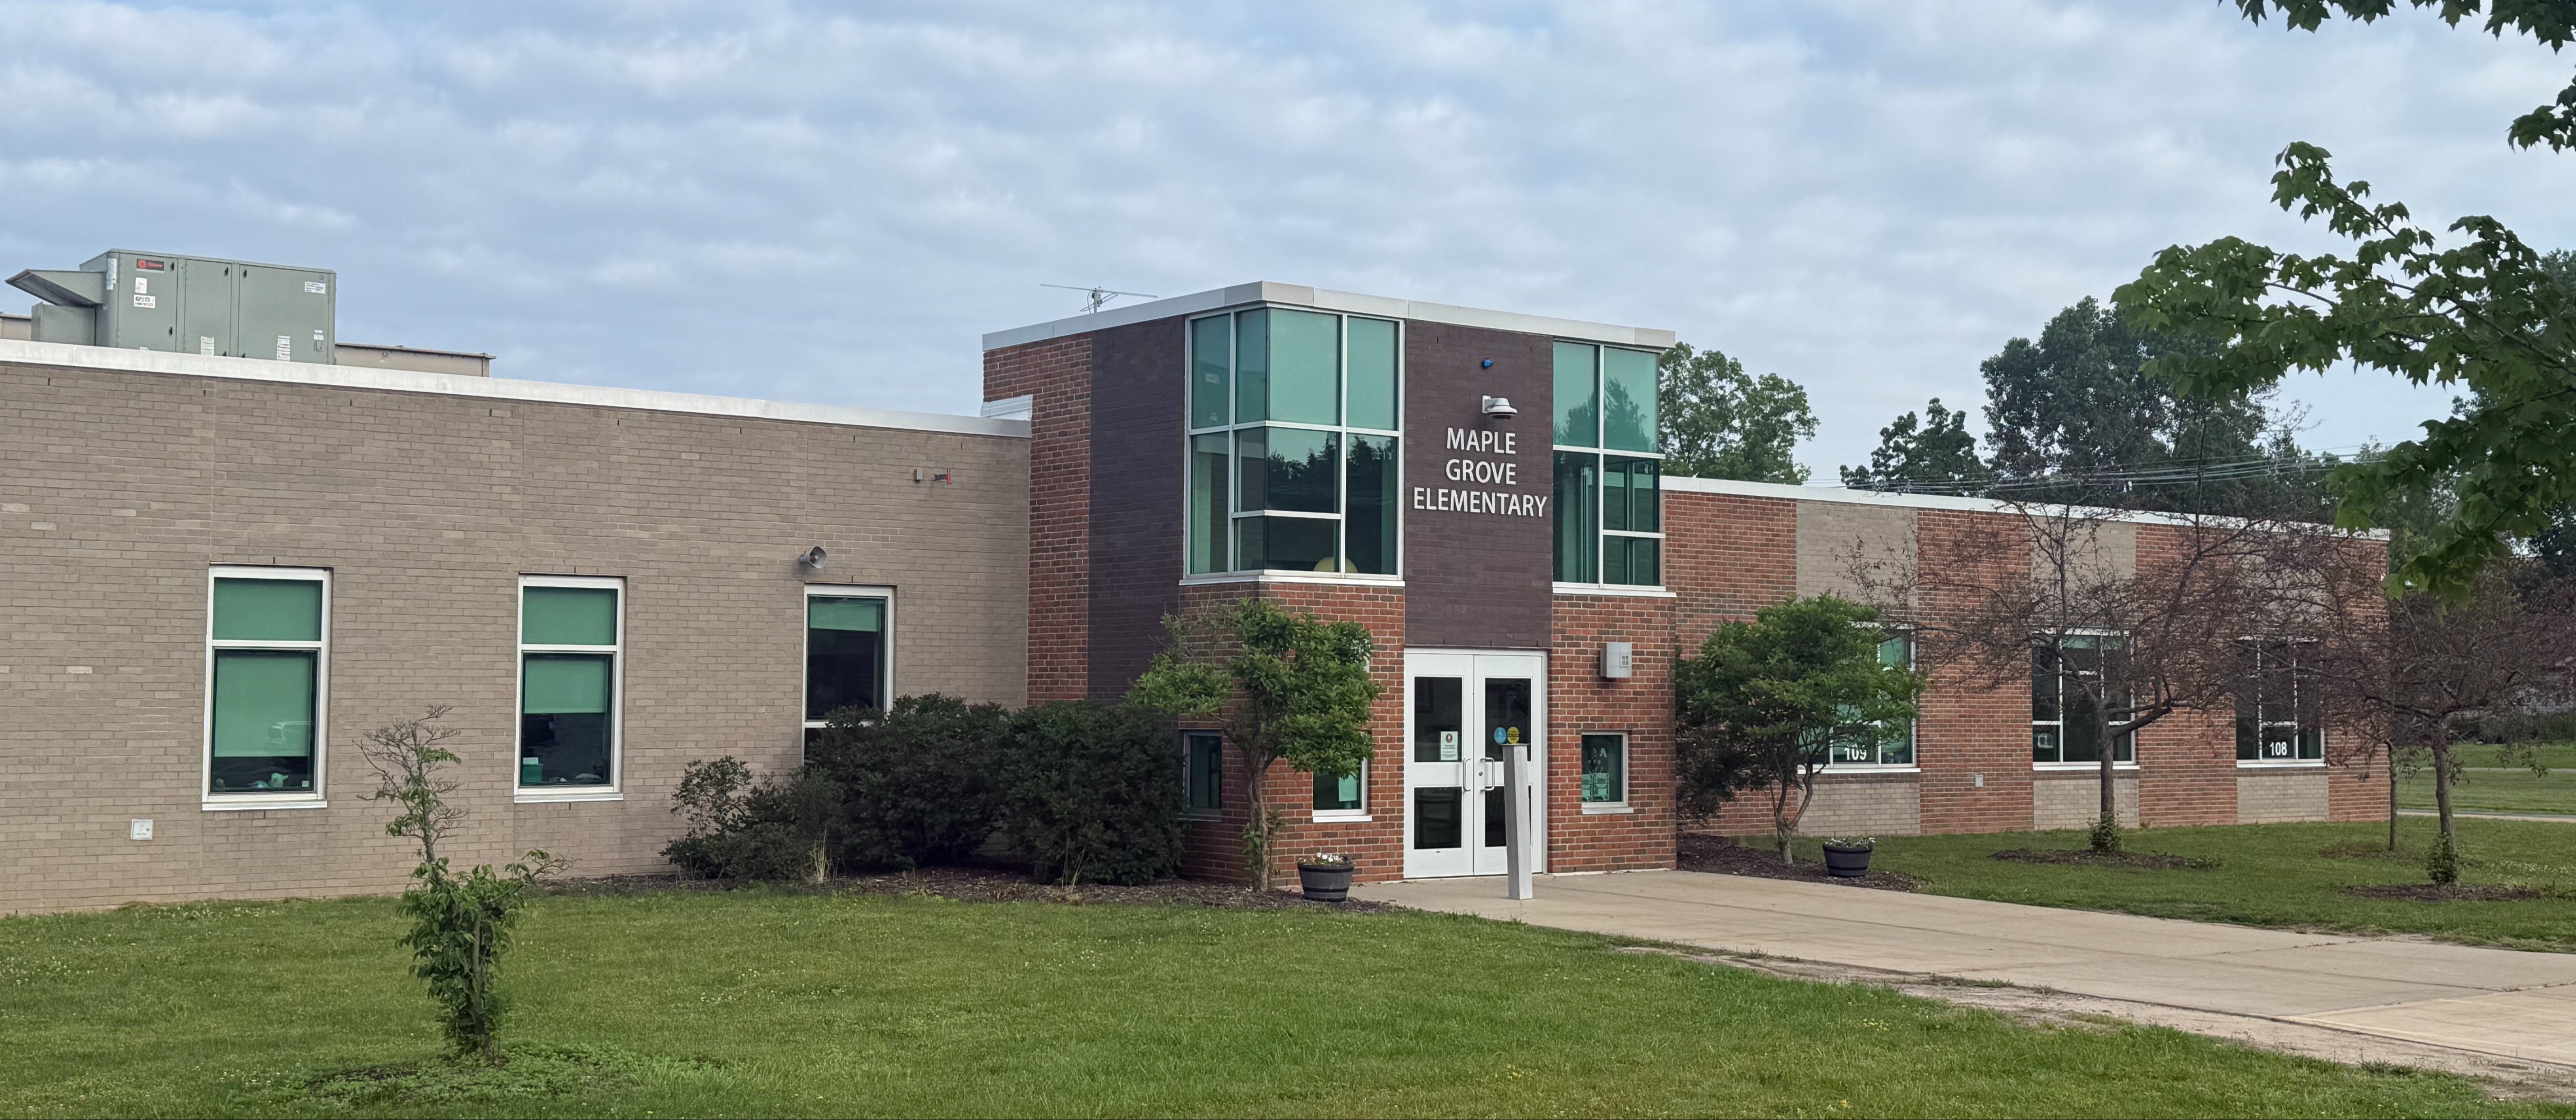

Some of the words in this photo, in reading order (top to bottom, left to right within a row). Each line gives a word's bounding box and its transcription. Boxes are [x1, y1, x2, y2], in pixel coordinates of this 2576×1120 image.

[1446, 427, 1516, 454] MAPLE
[1446, 459, 1516, 485] GROVE
[1413, 487, 1547, 517] ELEMENTARY
[1844, 744, 1867, 760] 109
[2269, 742, 2287, 756] 108
